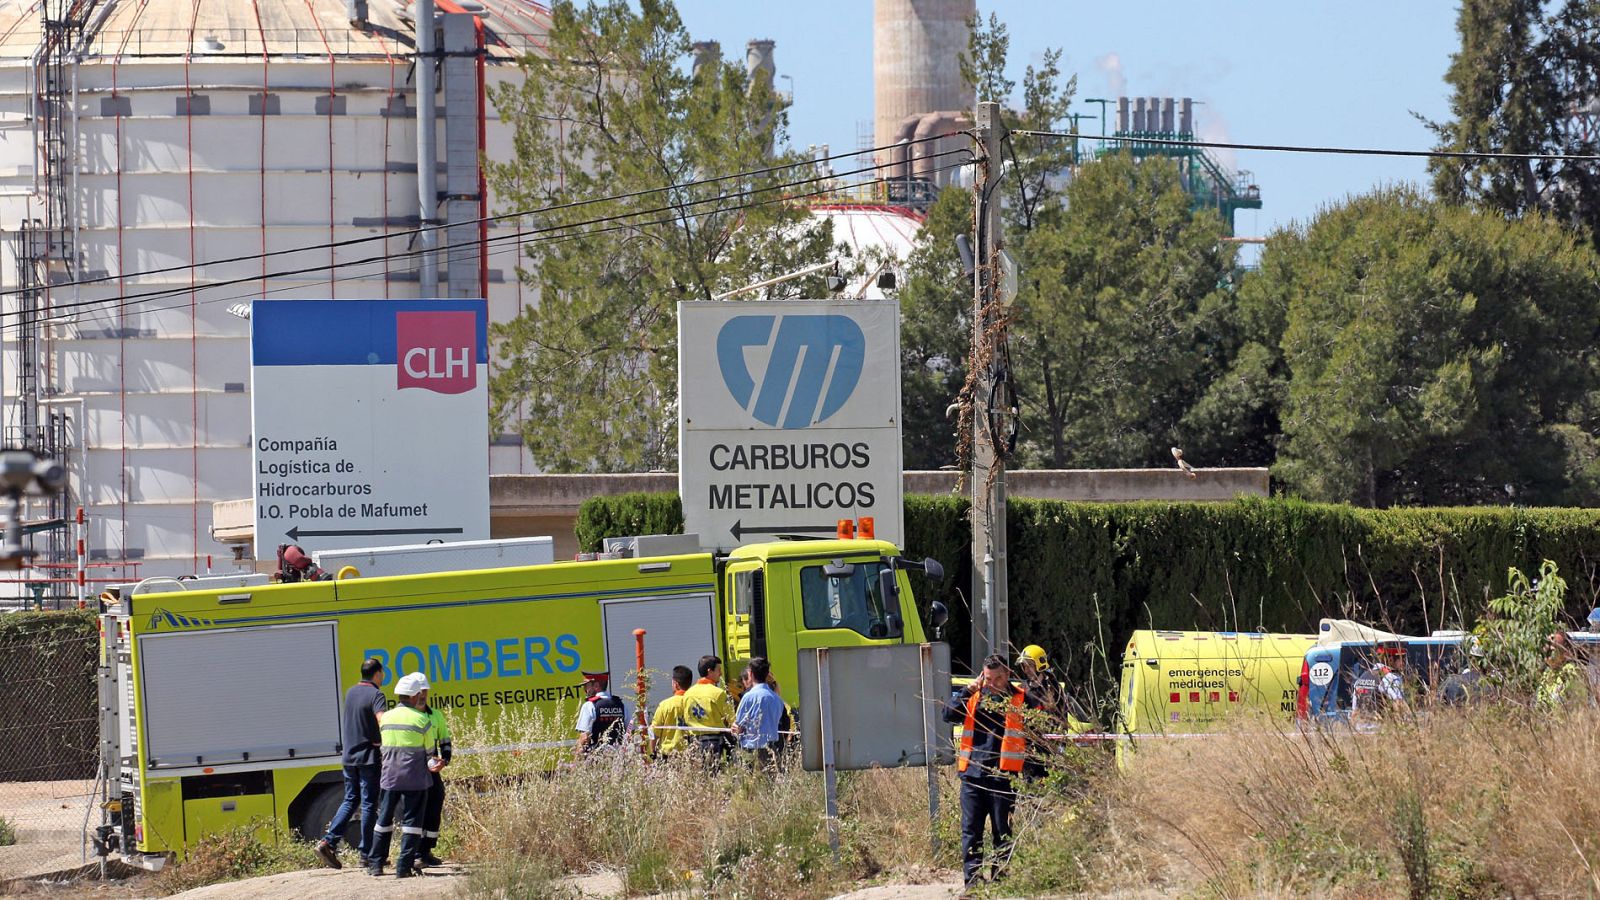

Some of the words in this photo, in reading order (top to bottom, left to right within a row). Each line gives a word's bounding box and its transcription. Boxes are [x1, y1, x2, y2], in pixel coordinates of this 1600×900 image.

[403, 347, 469, 379] CLH
[258, 437, 337, 454] Compañía
[709, 443, 870, 471] CARBUROS
[259, 460, 330, 477] Logística
[335, 459, 354, 473] de
[259, 482, 372, 496] Hidrocarburos
[709, 482, 875, 510] METALICOS
[259, 505, 284, 519] I.O.
[289, 504, 333, 518] Pobla
[338, 504, 356, 517] de
[361, 502, 428, 518] Mafumet
[364, 633, 581, 687] BOMBERS
[1313, 668, 1329, 677] 112
[470, 692, 489, 707] DE
[494, 685, 582, 705] SEGURETAT
